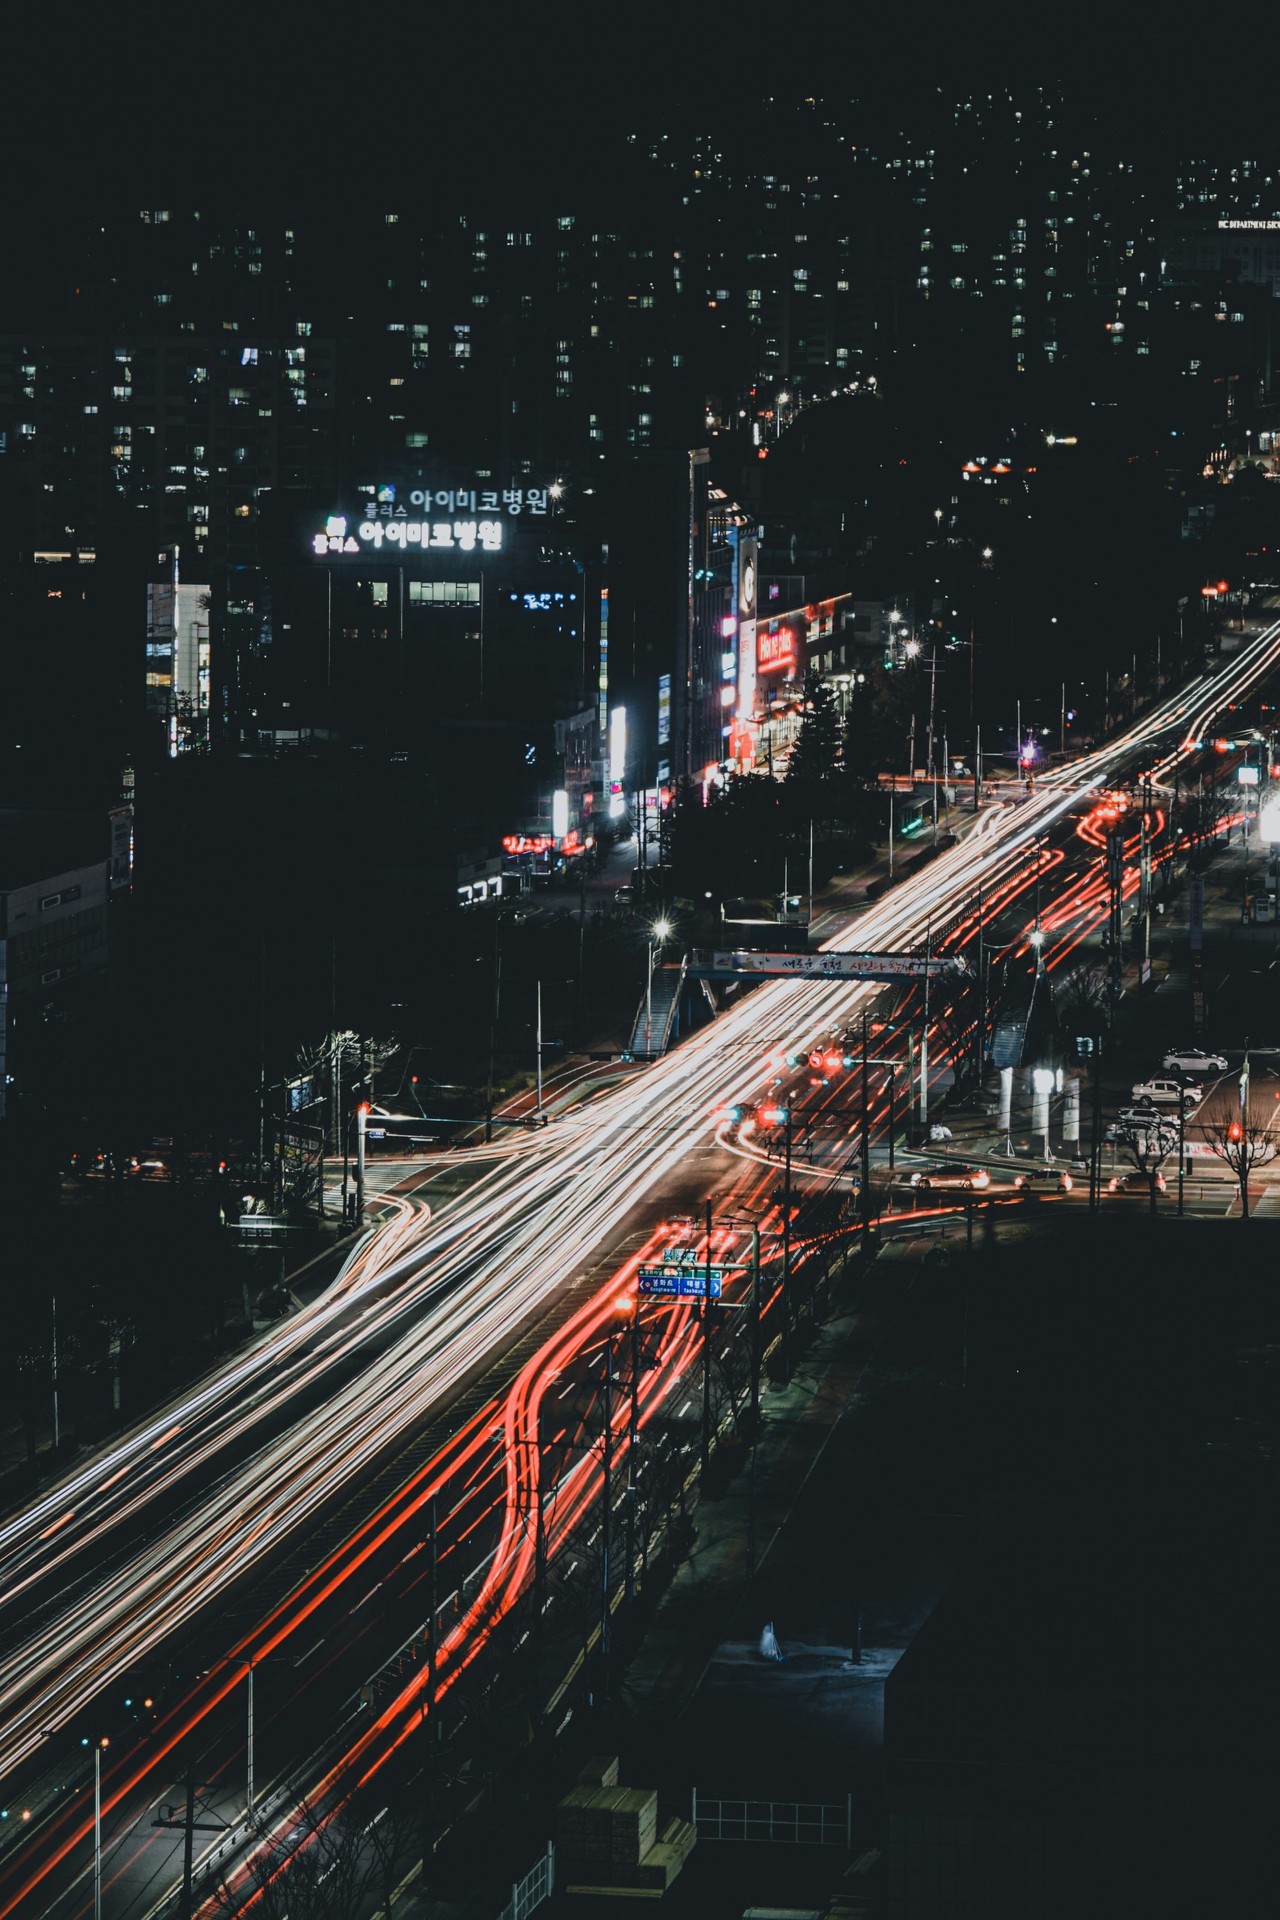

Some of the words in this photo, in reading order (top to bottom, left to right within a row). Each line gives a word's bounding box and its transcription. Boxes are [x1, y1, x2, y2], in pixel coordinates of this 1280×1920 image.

[364, 502, 408, 519] 플러스
[410, 488, 548, 515] 아이미코병원
[358, 521, 503, 551] 아이미코병원
